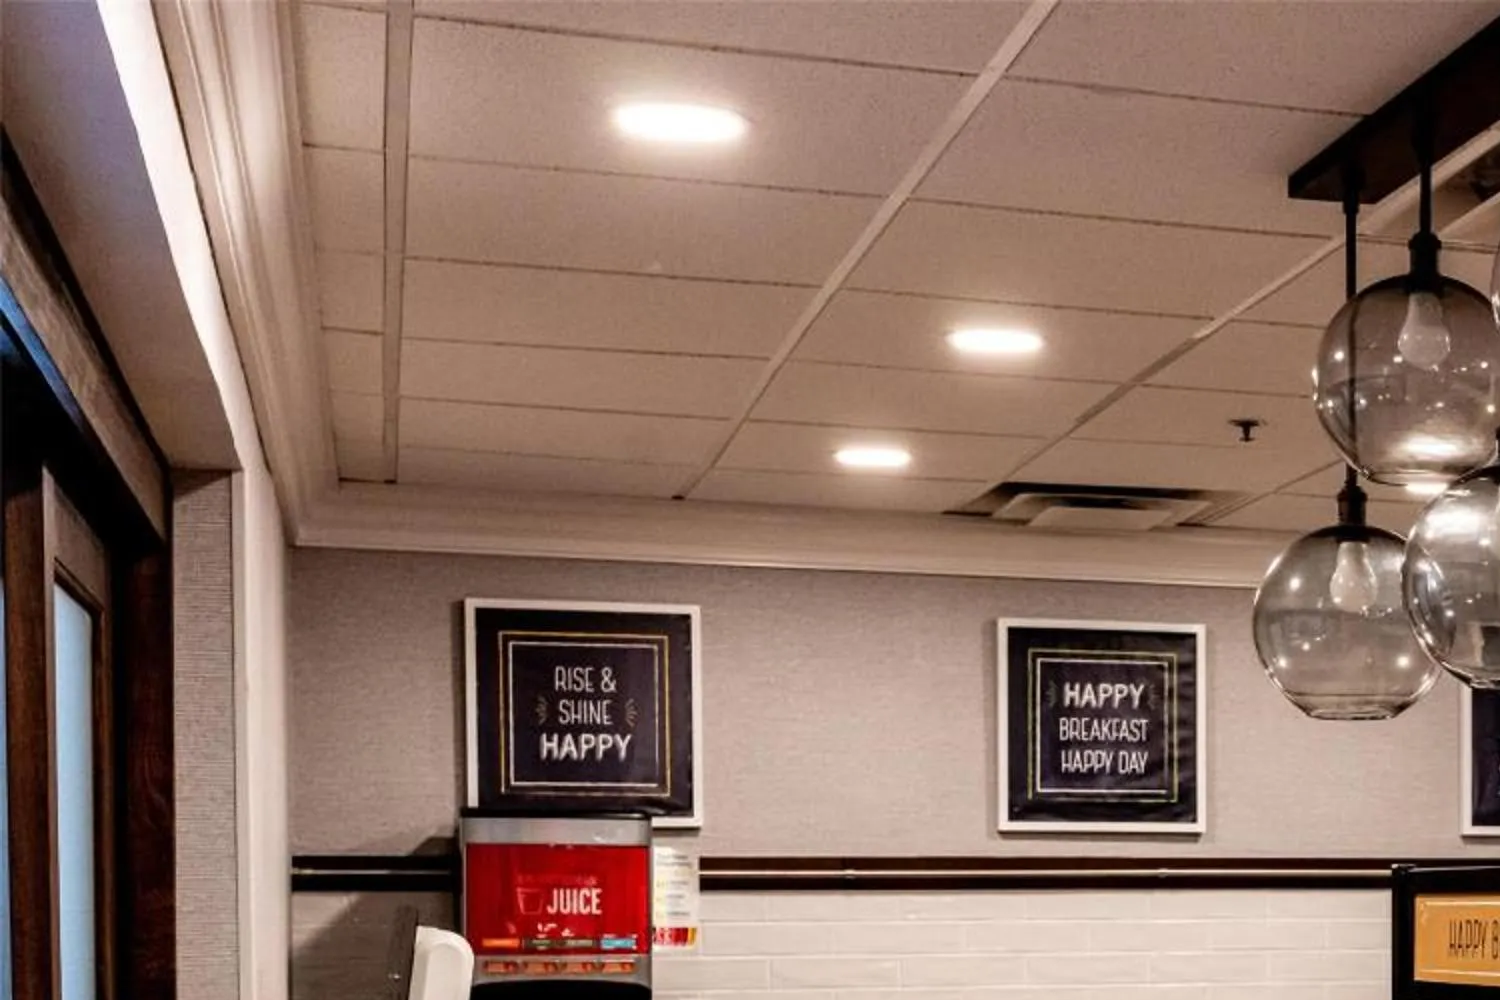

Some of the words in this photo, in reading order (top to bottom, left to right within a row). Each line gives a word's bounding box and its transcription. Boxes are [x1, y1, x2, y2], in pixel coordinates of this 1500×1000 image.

[554, 666, 595, 692] RISE
[601, 666, 617, 692] &
[1063, 682, 1144, 709] HAPPY
[558, 699, 613, 725] SHINE
[1059, 716, 1148, 742] BREAKFAST
[540, 733, 632, 761] HAPPY
[1061, 750, 1114, 774] HAPPY
[1118, 751, 1149, 775] DAY
[546, 887, 603, 915] JUICE
[1449, 919, 1487, 958] HAPPY
